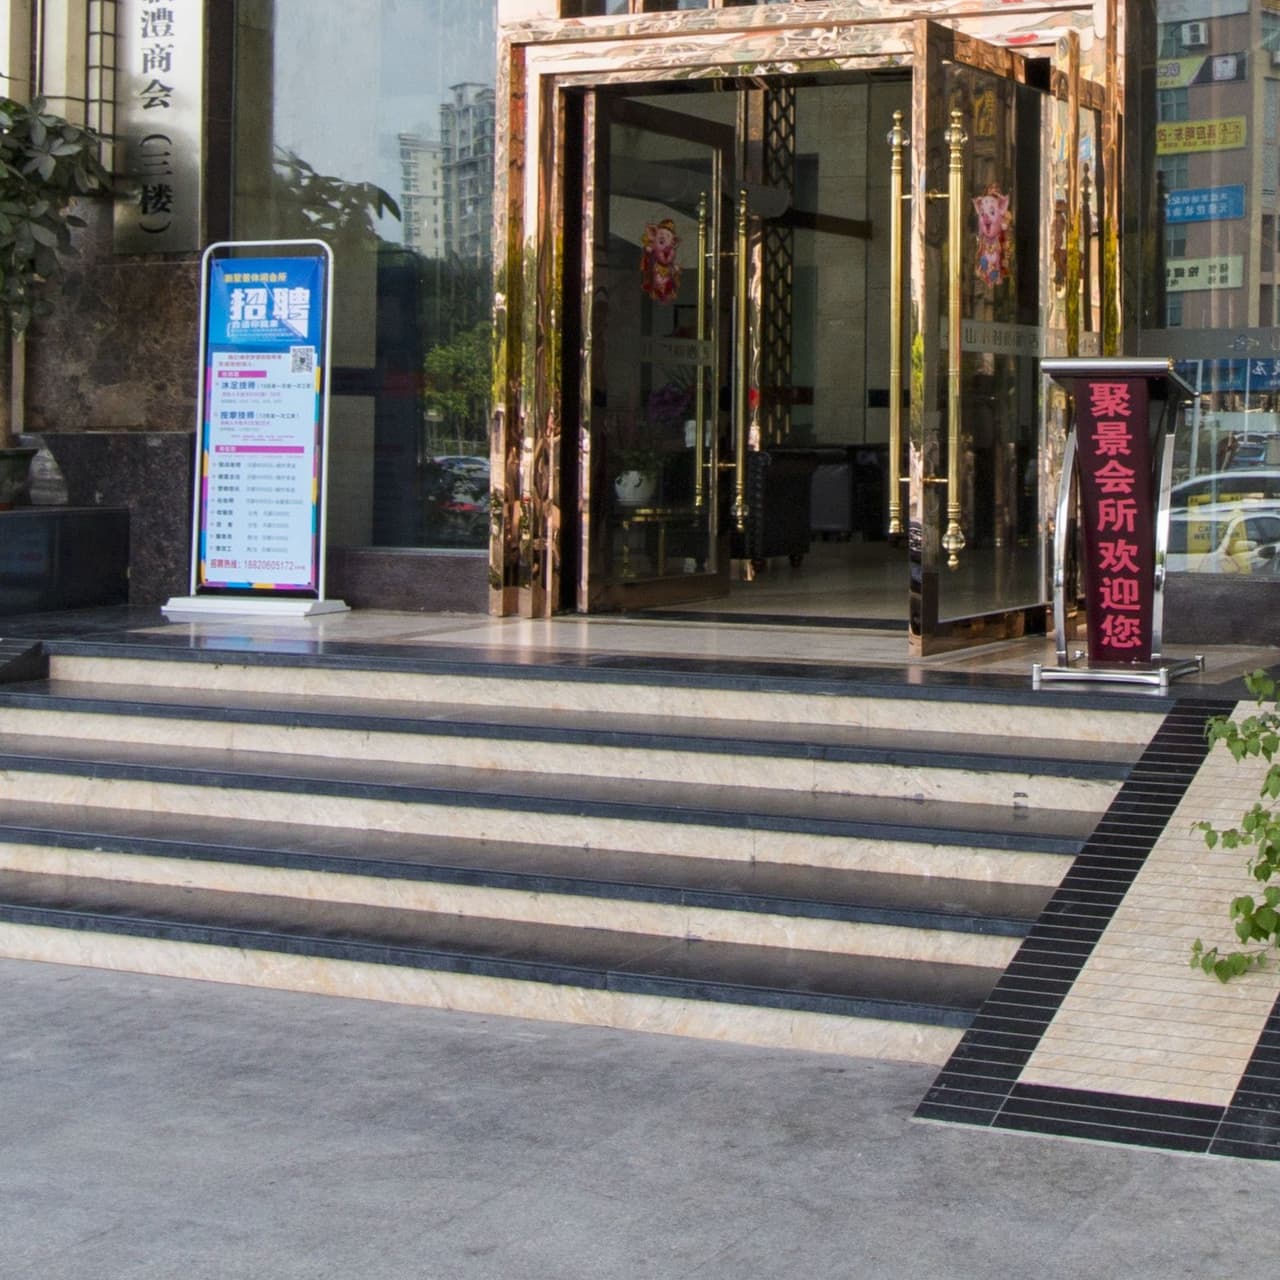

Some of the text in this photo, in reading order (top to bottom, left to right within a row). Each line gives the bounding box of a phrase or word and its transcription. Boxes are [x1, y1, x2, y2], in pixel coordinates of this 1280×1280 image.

[230, 287, 310, 336] 招聘
[1089, 382, 1143, 649] 聚景会所欢迎您
